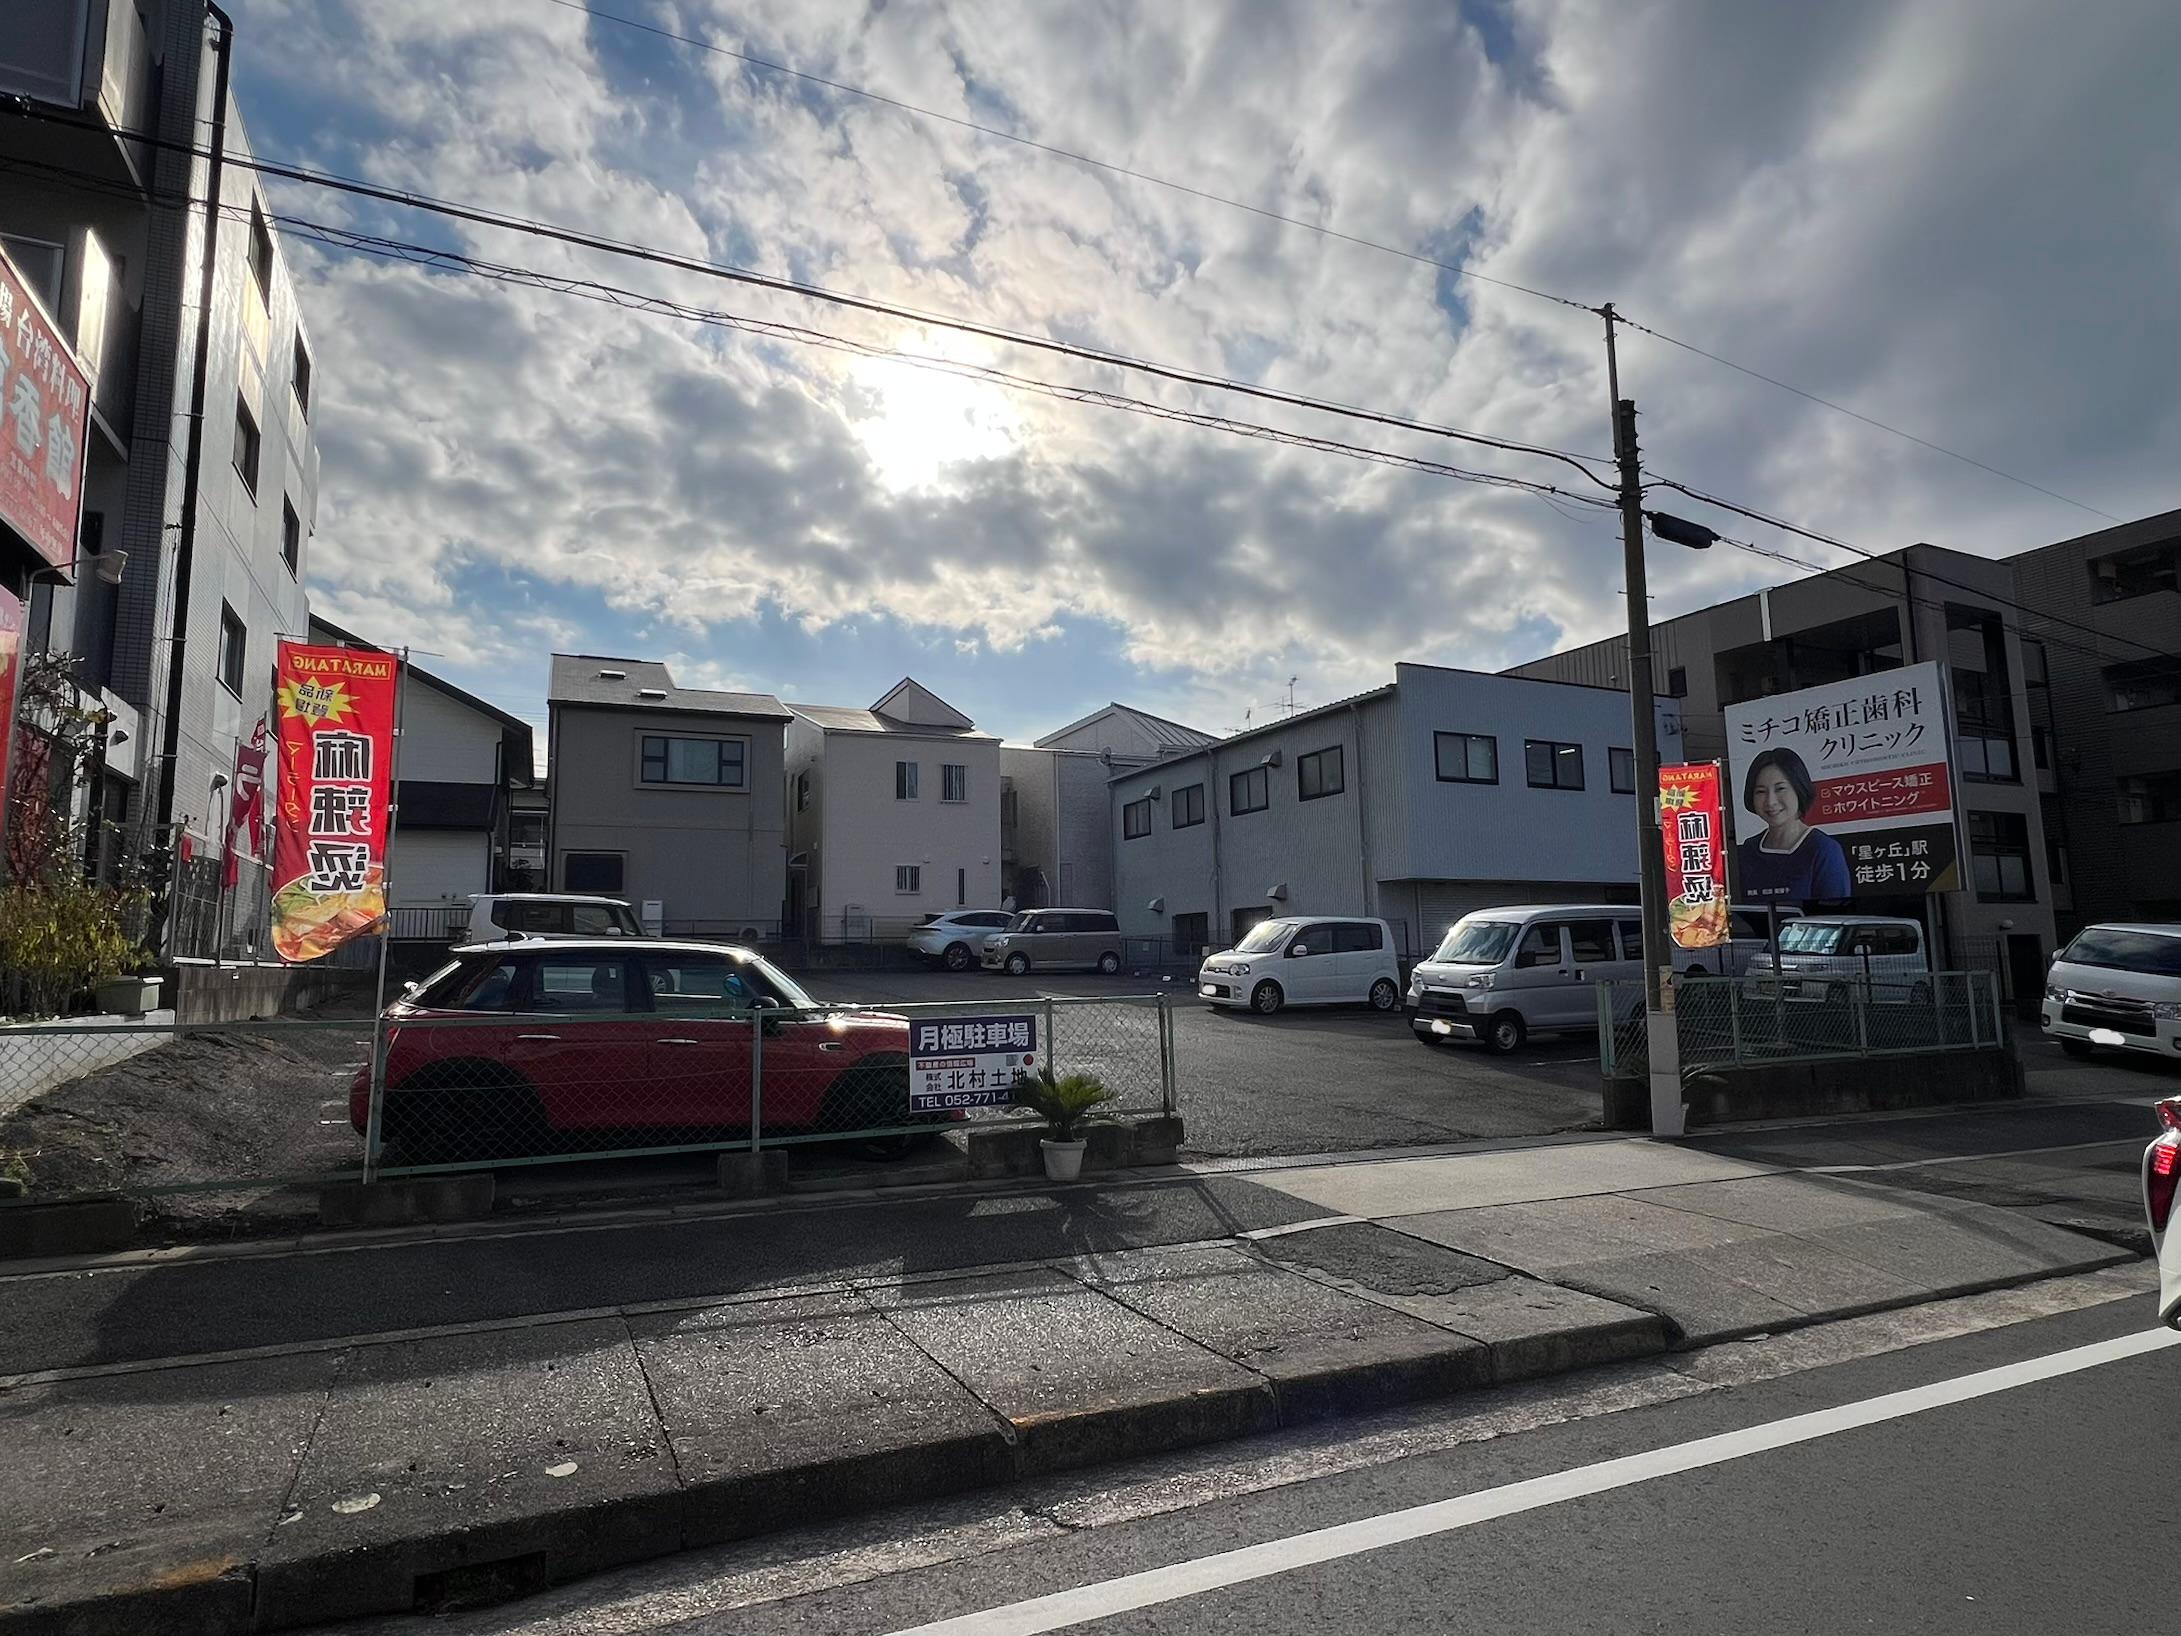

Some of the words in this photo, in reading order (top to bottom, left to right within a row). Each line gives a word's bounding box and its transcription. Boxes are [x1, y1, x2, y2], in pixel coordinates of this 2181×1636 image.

[0, 335, 75, 500] 香館
[1740, 687, 1922, 744] ミチコ矯正歯科
[1820, 722, 1925, 760] クリニック
[1831, 773, 1933, 797] マウスピース矯正
[1833, 791, 1919, 814] ホワイトニング
[1856, 861, 1931, 884] 徒歩1分
[918, 1022, 1029, 1051] 月極駐車場
[925, 1072, 942, 1081] 株式
[925, 1083, 942, 1092] 会社
[947, 1067, 1027, 1090] 北村土地
[918, 1097, 941, 1108] TEL
